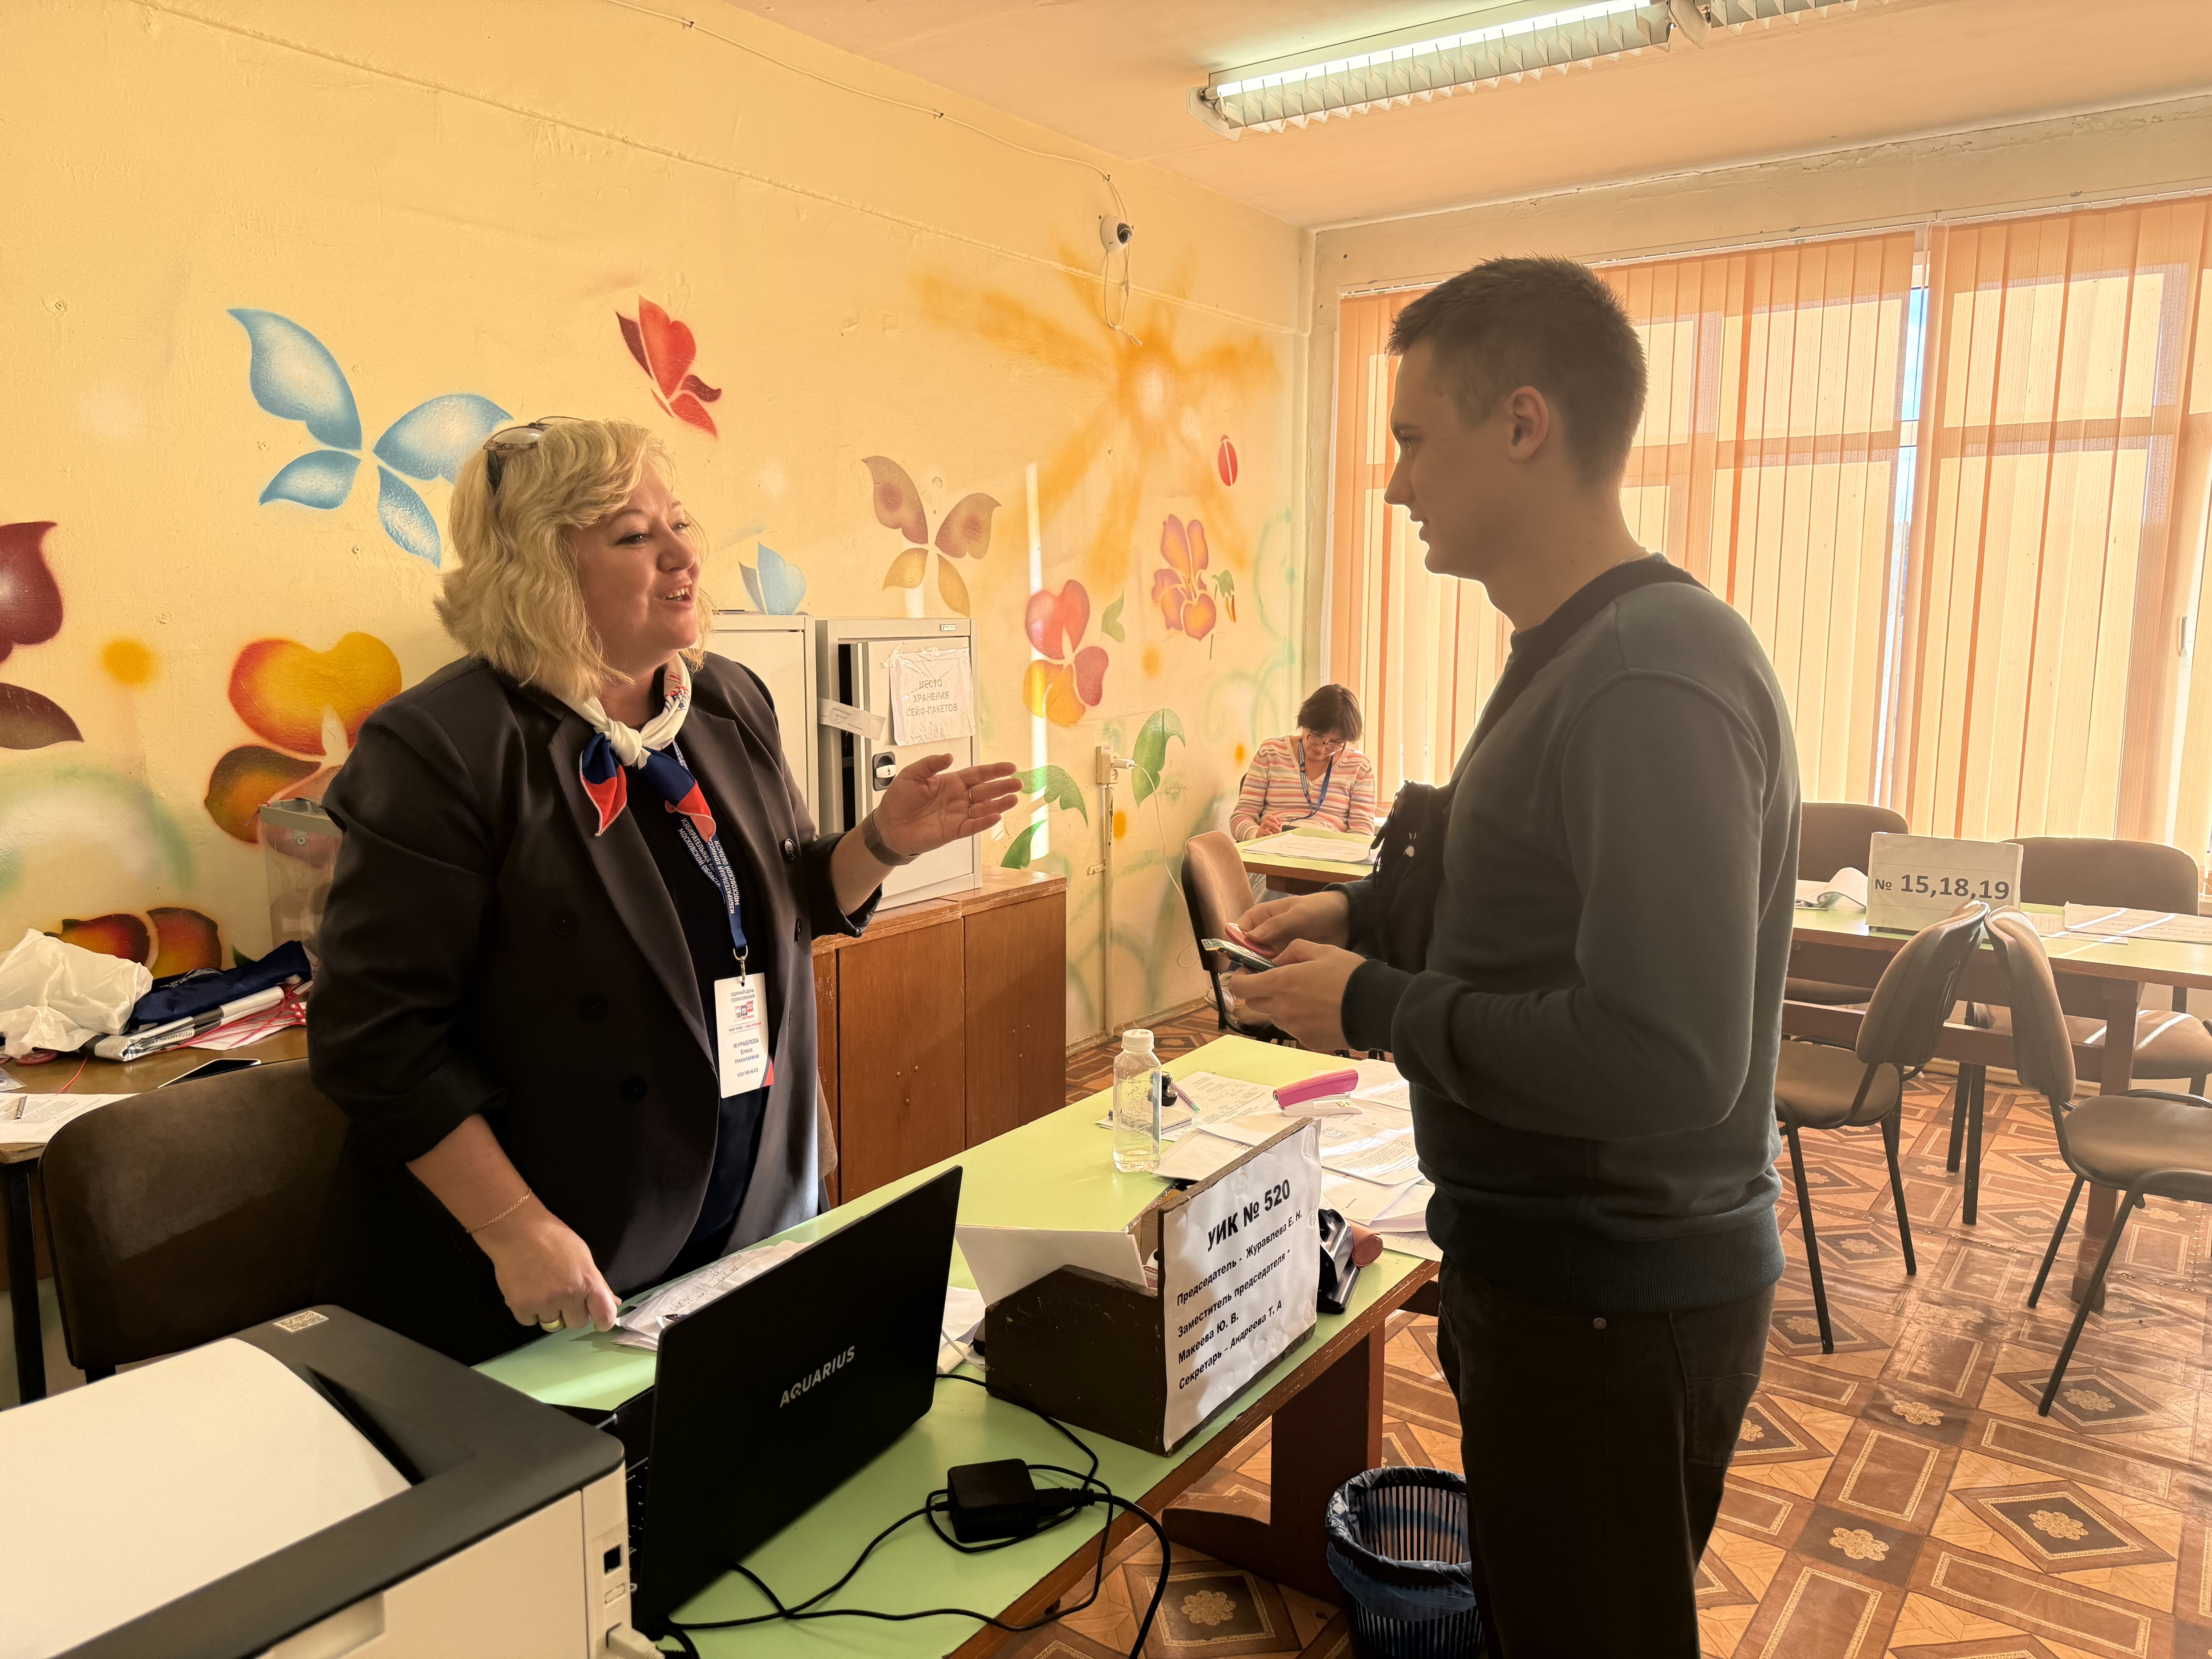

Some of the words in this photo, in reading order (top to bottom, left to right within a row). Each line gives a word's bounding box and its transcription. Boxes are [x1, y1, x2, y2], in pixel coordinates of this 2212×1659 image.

[913, 691, 949, 703] ХРАНЕНИЯ
[919, 679, 942, 689] МЕСТО
[906, 703, 958, 716] СЕЙФ-ПАКЕТОВ
[678, 828, 705, 866] МОСКОВСКОЙ
[702, 864, 721, 887] ОБЛАСТИ
[680, 818, 712, 863] ИЗБИРАТЕЛЬНАЯ
[714, 841, 728, 866] ОБЛАСТИ
[717, 866, 735, 914] ИЗБИРАТЕЛЬНАЯ
[724, 866, 740, 905] МОСКОВСКОЙ
[1875, 879, 1892, 891] №
[1901, 874, 2009, 900] 15,18,19
[733, 1038, 759, 1048] ЖУРАВЛЕВА
[1208, 1212, 1238, 1252] УИК
[1243, 1201, 1259, 1227] №
[1264, 1179, 1290, 1211] 520
[1177, 1260, 1237, 1306] Председатель
[1246, 1224, 1286, 1259] Журавлева
[1288, 1216, 1294, 1228] Е.
[1296, 1210, 1302, 1221] Н.
[1178, 1293, 1232, 1338] Заместитель
[1234, 1253, 1285, 1297] председателя
[1178, 1330, 1214, 1364] Макеева
[1217, 1320, 1228, 1334] Ю.
[1230, 1312, 1238, 1324] В.
[1179, 1351, 1222, 1389] Секретарь
[1230, 1314, 1266, 1349] Андреева
[1268, 1306, 1274, 1317] Т.
[1276, 1300, 1282, 1312] А
[780, 1346, 855, 1408] AQUARIUS
